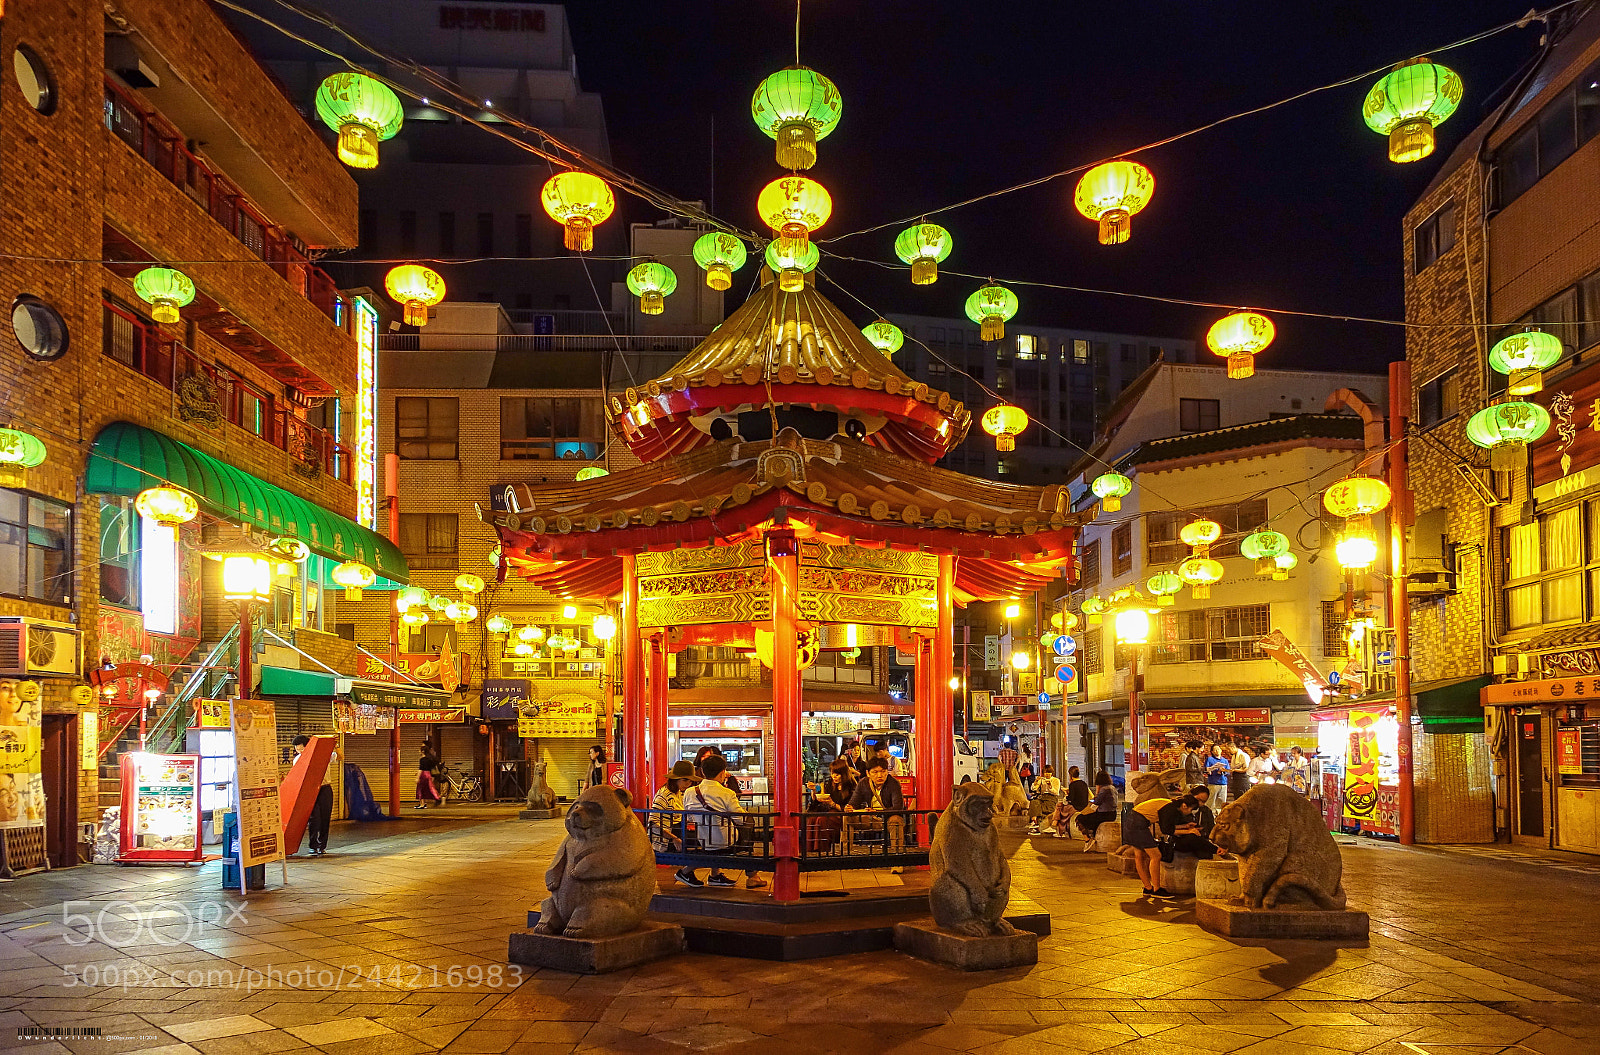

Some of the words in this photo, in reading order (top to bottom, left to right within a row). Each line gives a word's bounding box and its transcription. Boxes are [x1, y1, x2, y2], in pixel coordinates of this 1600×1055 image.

[542, 706, 593, 714] ラーメン専門店
